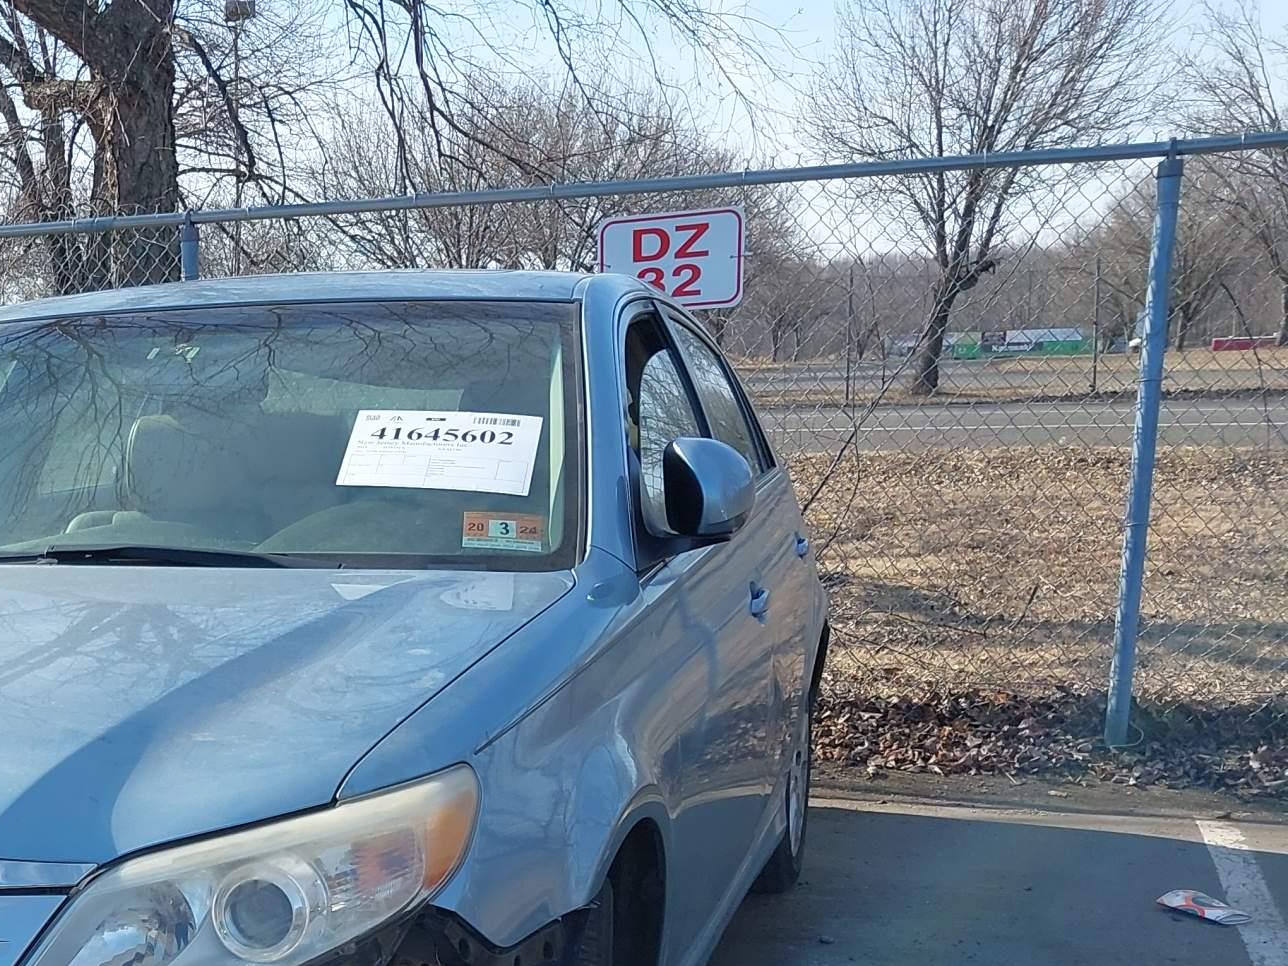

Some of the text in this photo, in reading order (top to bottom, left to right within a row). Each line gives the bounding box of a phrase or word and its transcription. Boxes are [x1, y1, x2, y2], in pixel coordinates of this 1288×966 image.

[633, 223, 710, 263] DZ
[637, 264, 702, 298] 32
[370, 426, 514, 446] 41645602
[499, 521, 510, 535] 3
